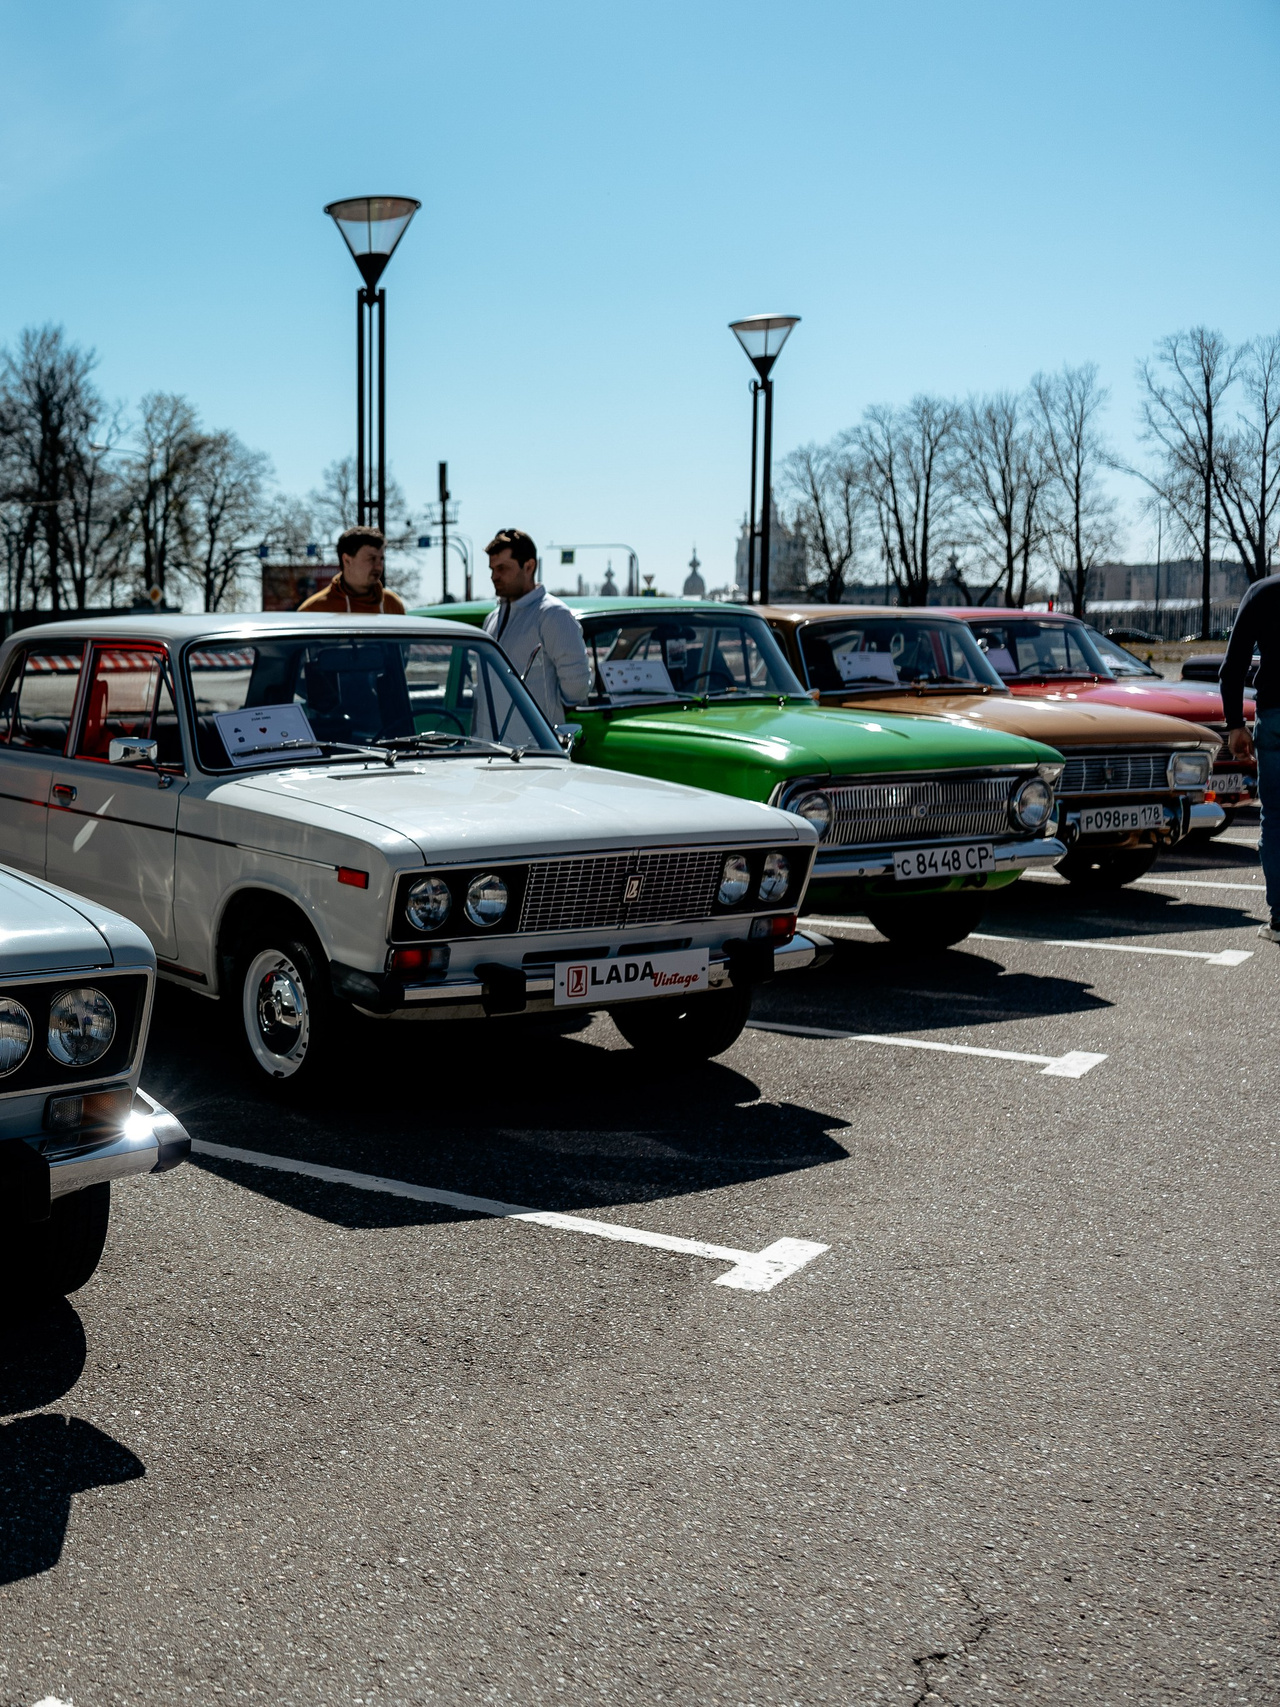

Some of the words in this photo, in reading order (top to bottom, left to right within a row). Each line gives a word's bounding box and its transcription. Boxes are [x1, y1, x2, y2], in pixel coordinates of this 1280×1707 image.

[1085, 810, 1138, 830] Р098РВ
[1141, 806, 1160, 821] 178
[966, 847, 989, 869] СР
[591, 961, 655, 986] LADA
[652, 972, 700, 988] Vintage
